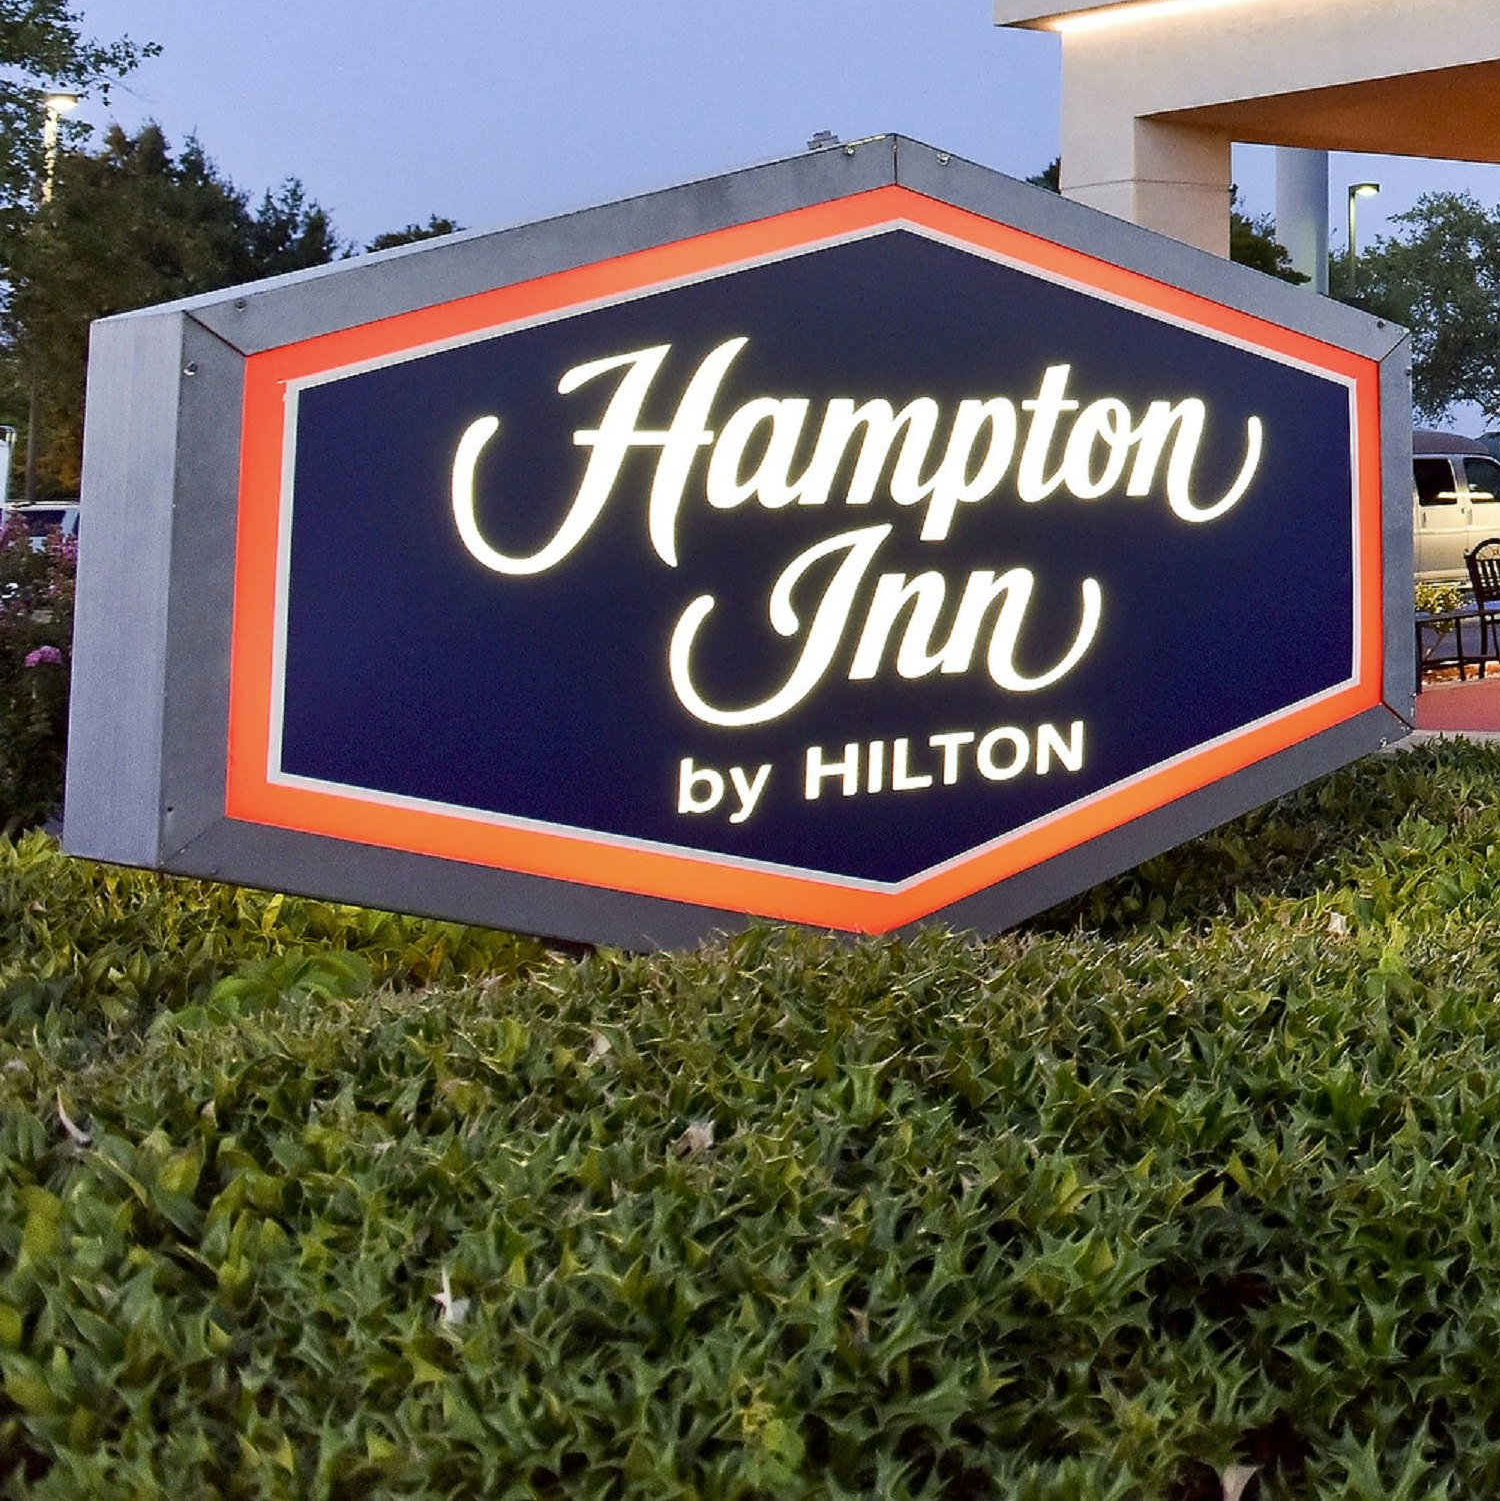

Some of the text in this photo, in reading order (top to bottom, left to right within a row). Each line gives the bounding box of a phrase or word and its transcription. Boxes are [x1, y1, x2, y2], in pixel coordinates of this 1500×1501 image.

[451, 336, 1264, 575] Hampton
[669, 523, 1102, 727] Inn
[677, 719, 1086, 825] by HILTON
